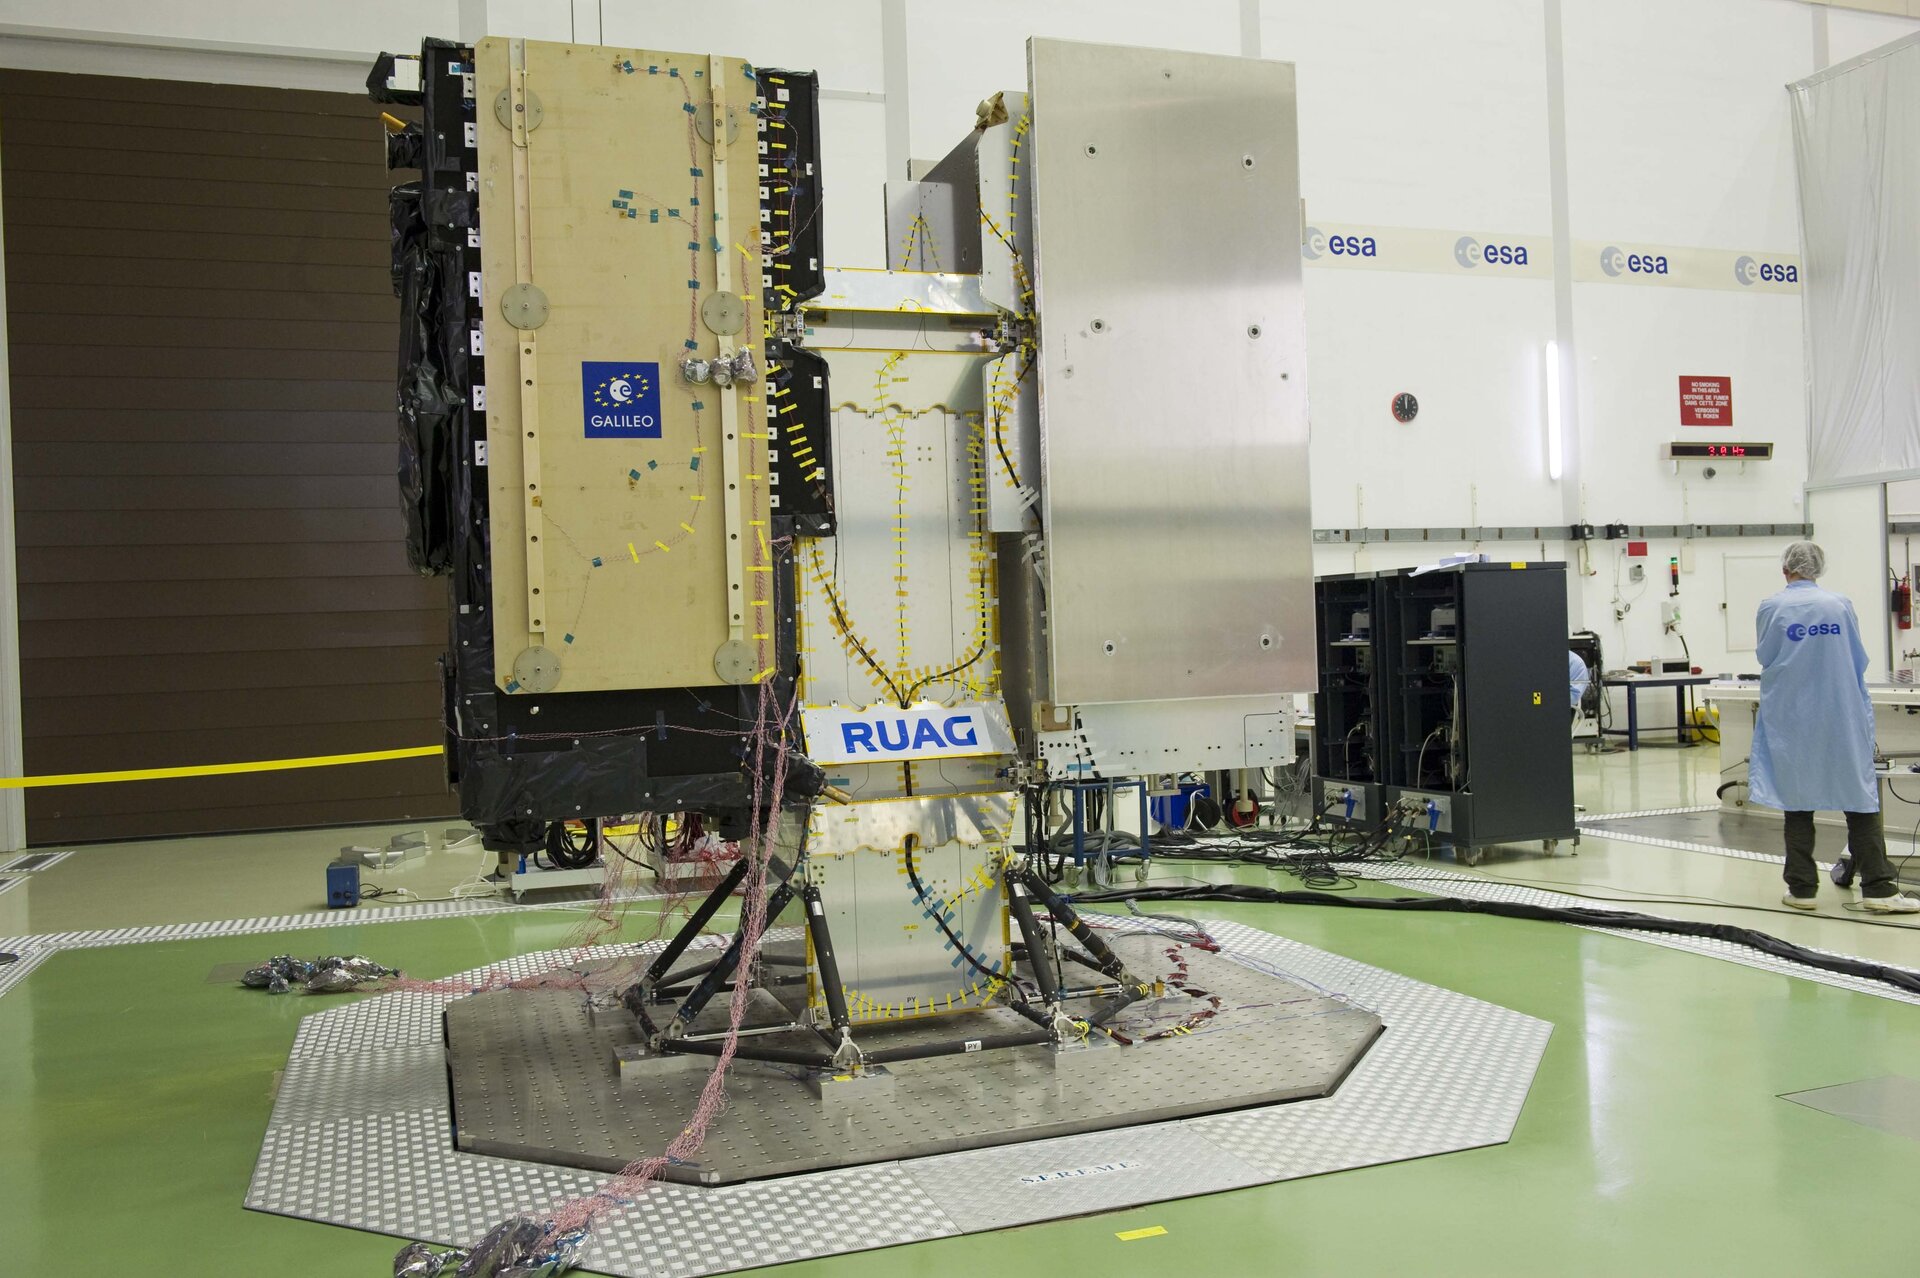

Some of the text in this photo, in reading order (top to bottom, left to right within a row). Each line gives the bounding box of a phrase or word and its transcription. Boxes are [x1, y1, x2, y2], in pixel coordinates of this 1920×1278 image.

[1328, 235, 1377, 257] esa
[1483, 244, 1528, 265] esa
[1627, 254, 1669, 274] esa
[1760, 263, 1798, 283] esa
[591, 415, 654, 428] GALILEO
[1808, 623, 1841, 636] esa
[840, 715, 978, 754] RUAG
[967, 1042, 978, 1050] PY
